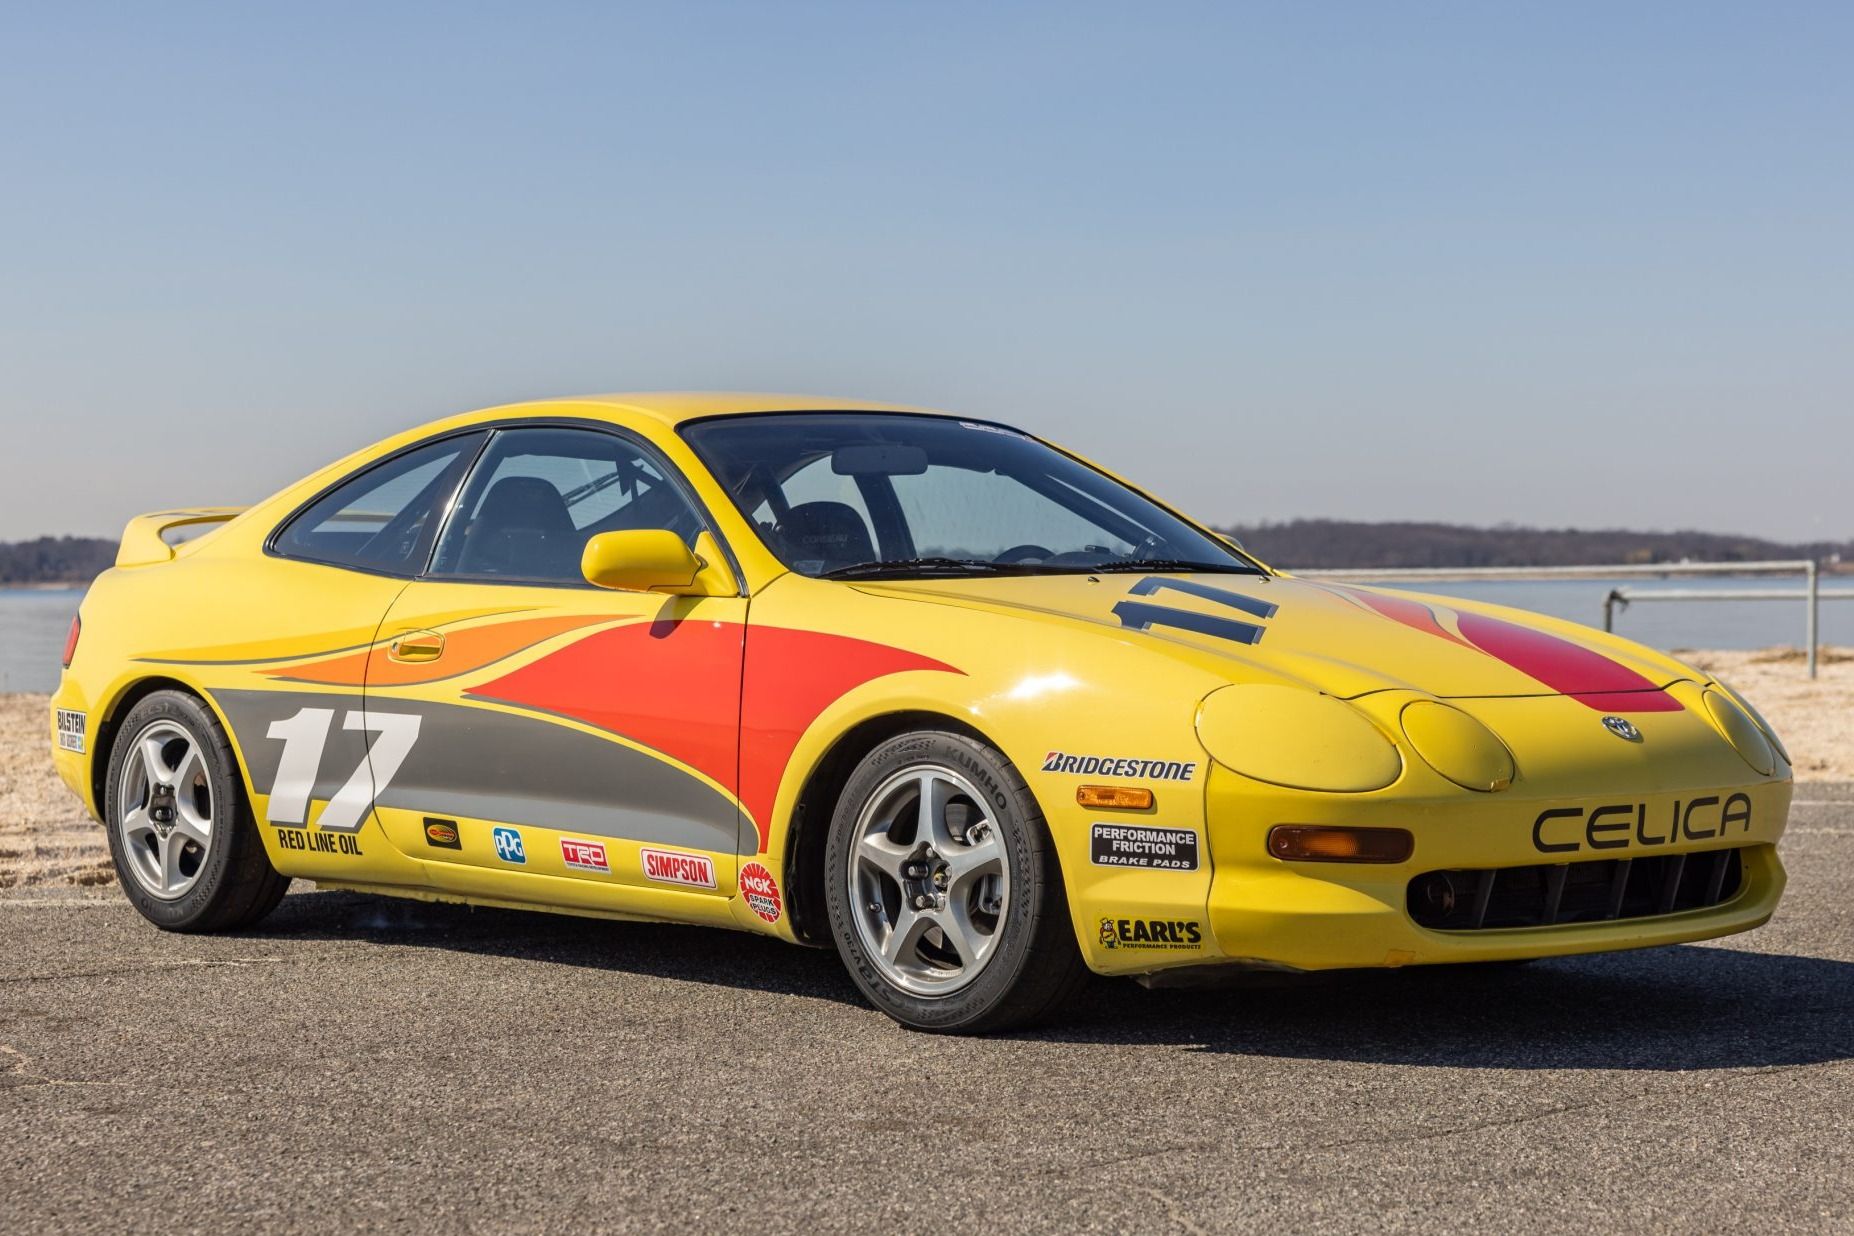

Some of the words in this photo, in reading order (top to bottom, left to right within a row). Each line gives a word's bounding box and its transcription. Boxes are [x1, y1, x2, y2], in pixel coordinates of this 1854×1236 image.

[57, 711, 86, 735] BILSTEIN
[265, 707, 423, 834] 17
[946, 747, 1007, 810] KUMHO
[1042, 752, 1196, 781] BRIDGESTONE
[1094, 826, 1195, 845] PERFORMANCE
[1532, 793, 1752, 854] CELICA
[278, 829, 305, 850] RED
[307, 833, 337, 853] LINE
[339, 835, 363, 856] OIL
[495, 831, 523, 859] PPG
[562, 844, 605, 862] TRD
[1112, 840, 1176, 856] FRICTION
[647, 854, 710, 884] SIMPSON
[1098, 855, 1149, 867] BRAKE
[1152, 860, 1191, 869] PADS
[743, 876, 773, 894] NGK
[750, 894, 775, 906] SPARK
[751, 903, 777, 915] PLUGS
[1117, 919, 1201, 943] EARL'S
